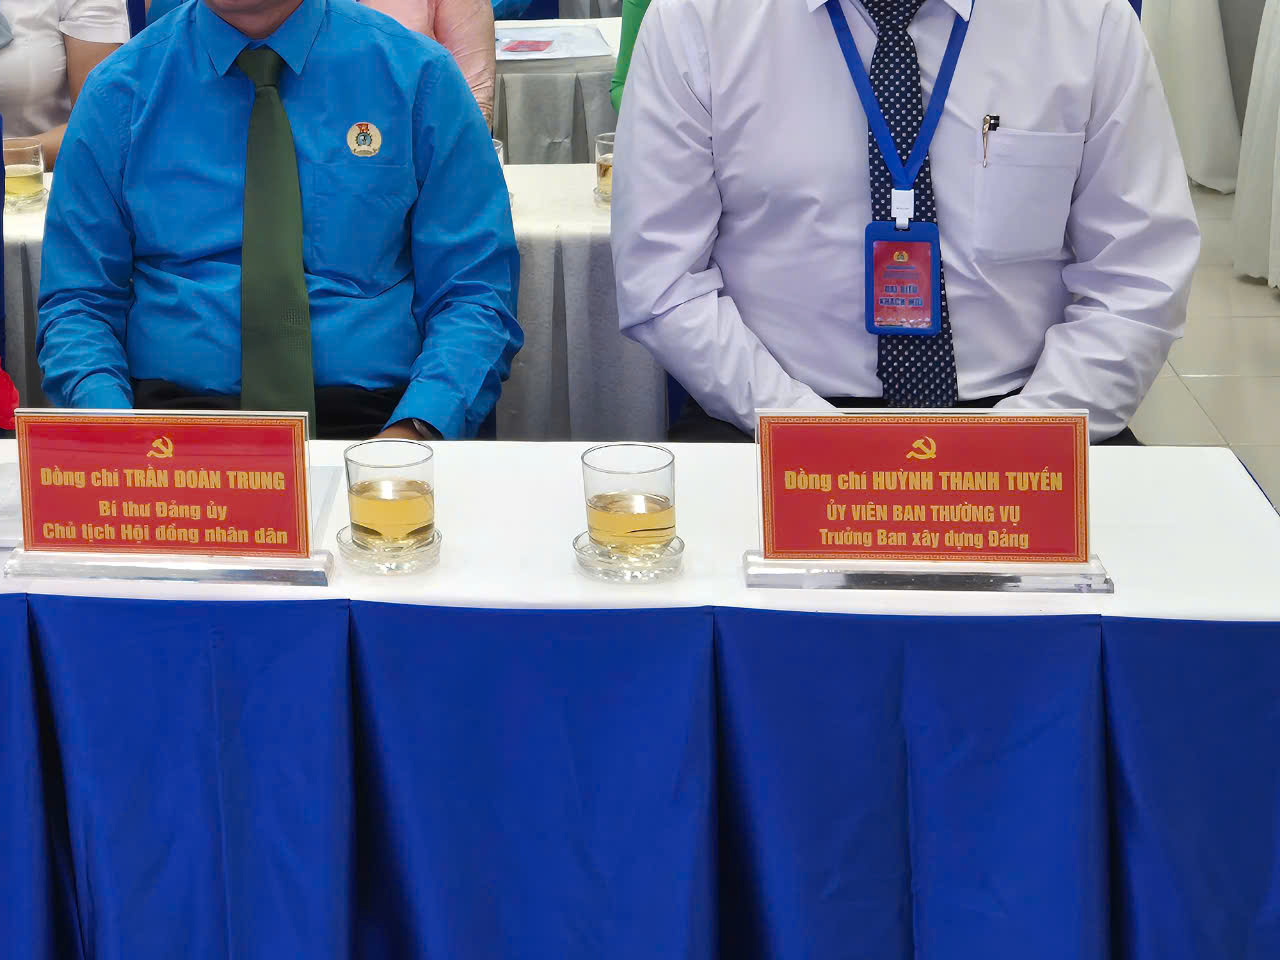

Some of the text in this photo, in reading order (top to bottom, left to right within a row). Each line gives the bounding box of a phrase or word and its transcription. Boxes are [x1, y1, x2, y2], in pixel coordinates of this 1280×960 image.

[39, 463, 286, 491] Đồng chí TRẦN ĐOÀN TRUNG
[783, 467, 833, 493] Đồng
[837, 470, 868, 491] chí
[872, 468, 934, 492] HUỲNH
[938, 471, 1001, 492] THANH
[98, 499, 228, 521] Bí thư Đảng ủy
[826, 498, 1021, 527] ỦY VIÊN BAN THƯỜNG VỤ
[42, 520, 289, 546] Chủ tịch Hội đồng nhân dân
[818, 526, 1029, 551] Trưởng Ban xây dựng Đảng
